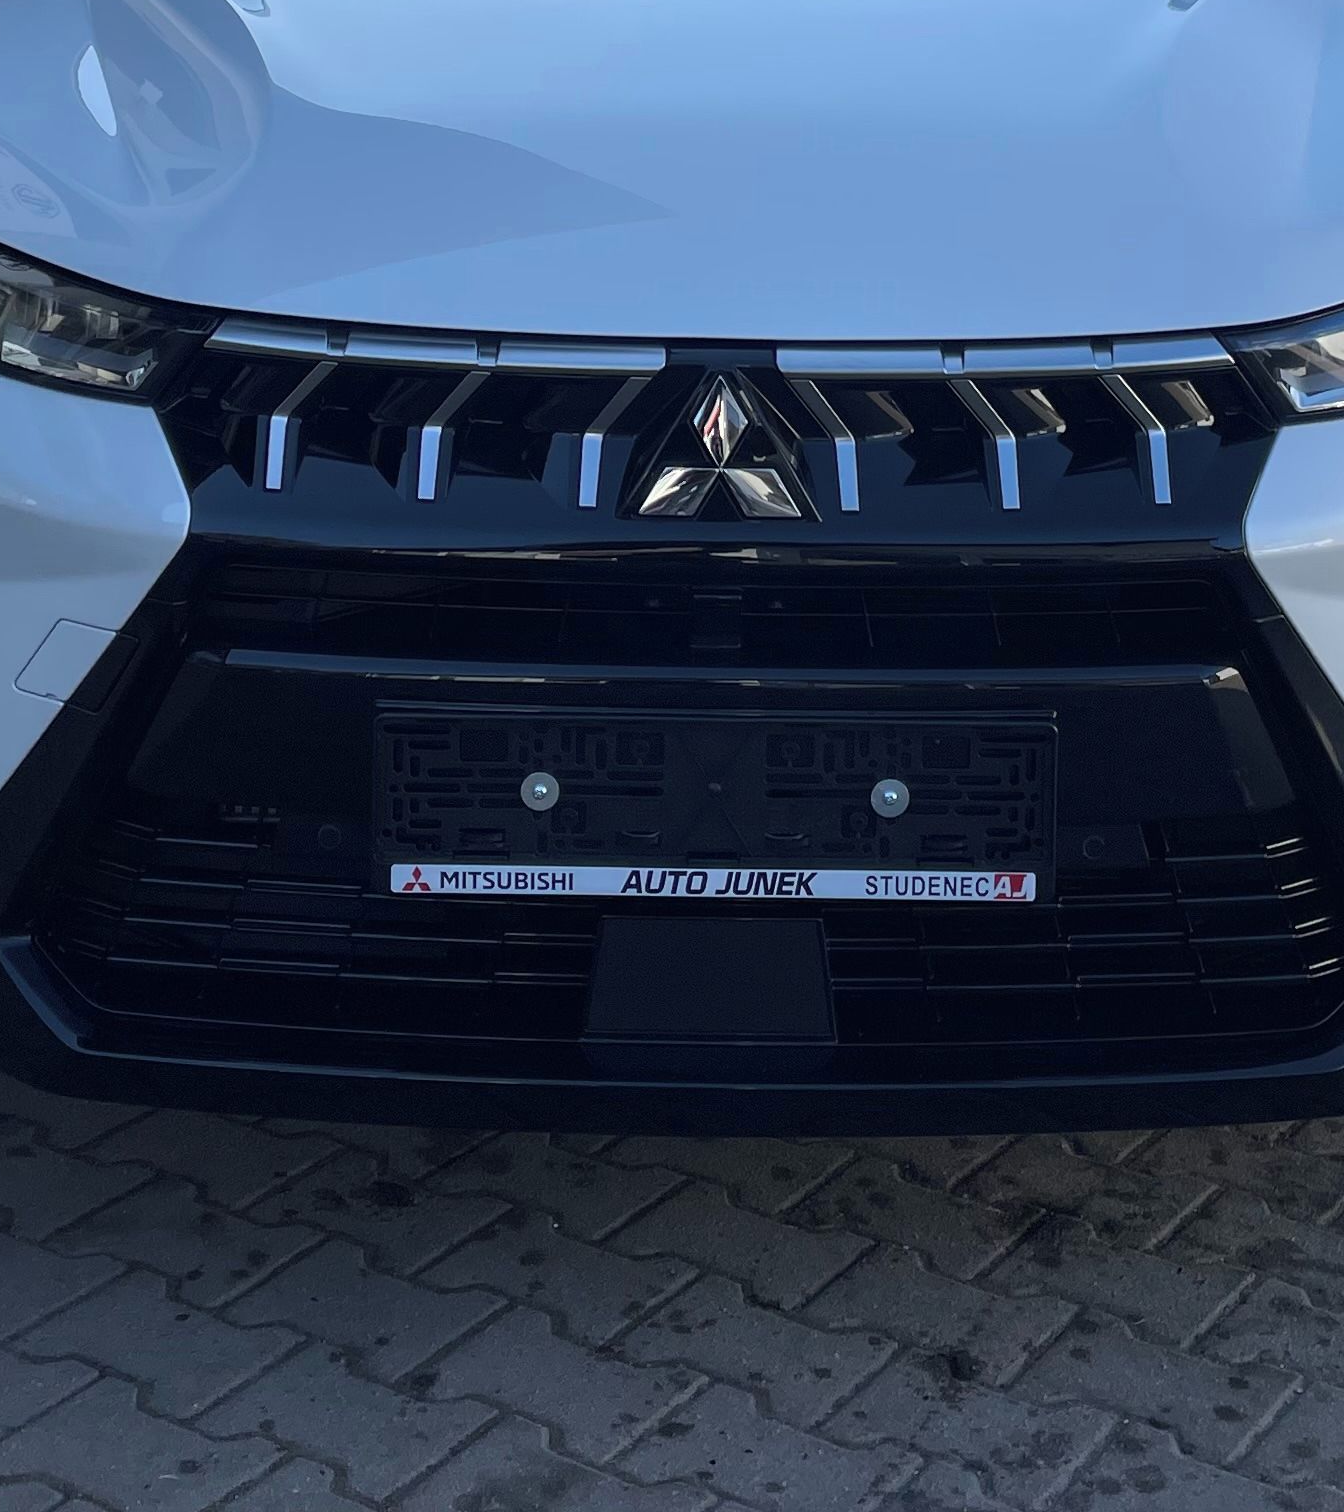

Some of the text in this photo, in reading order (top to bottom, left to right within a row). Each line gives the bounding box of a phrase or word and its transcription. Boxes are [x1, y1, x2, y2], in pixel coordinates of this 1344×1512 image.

[439, 870, 574, 892] MITSUBISHI
[621, 869, 708, 895] AUTO
[715, 871, 818, 896] JUNEK
[865, 875, 989, 897] STUDENEC
